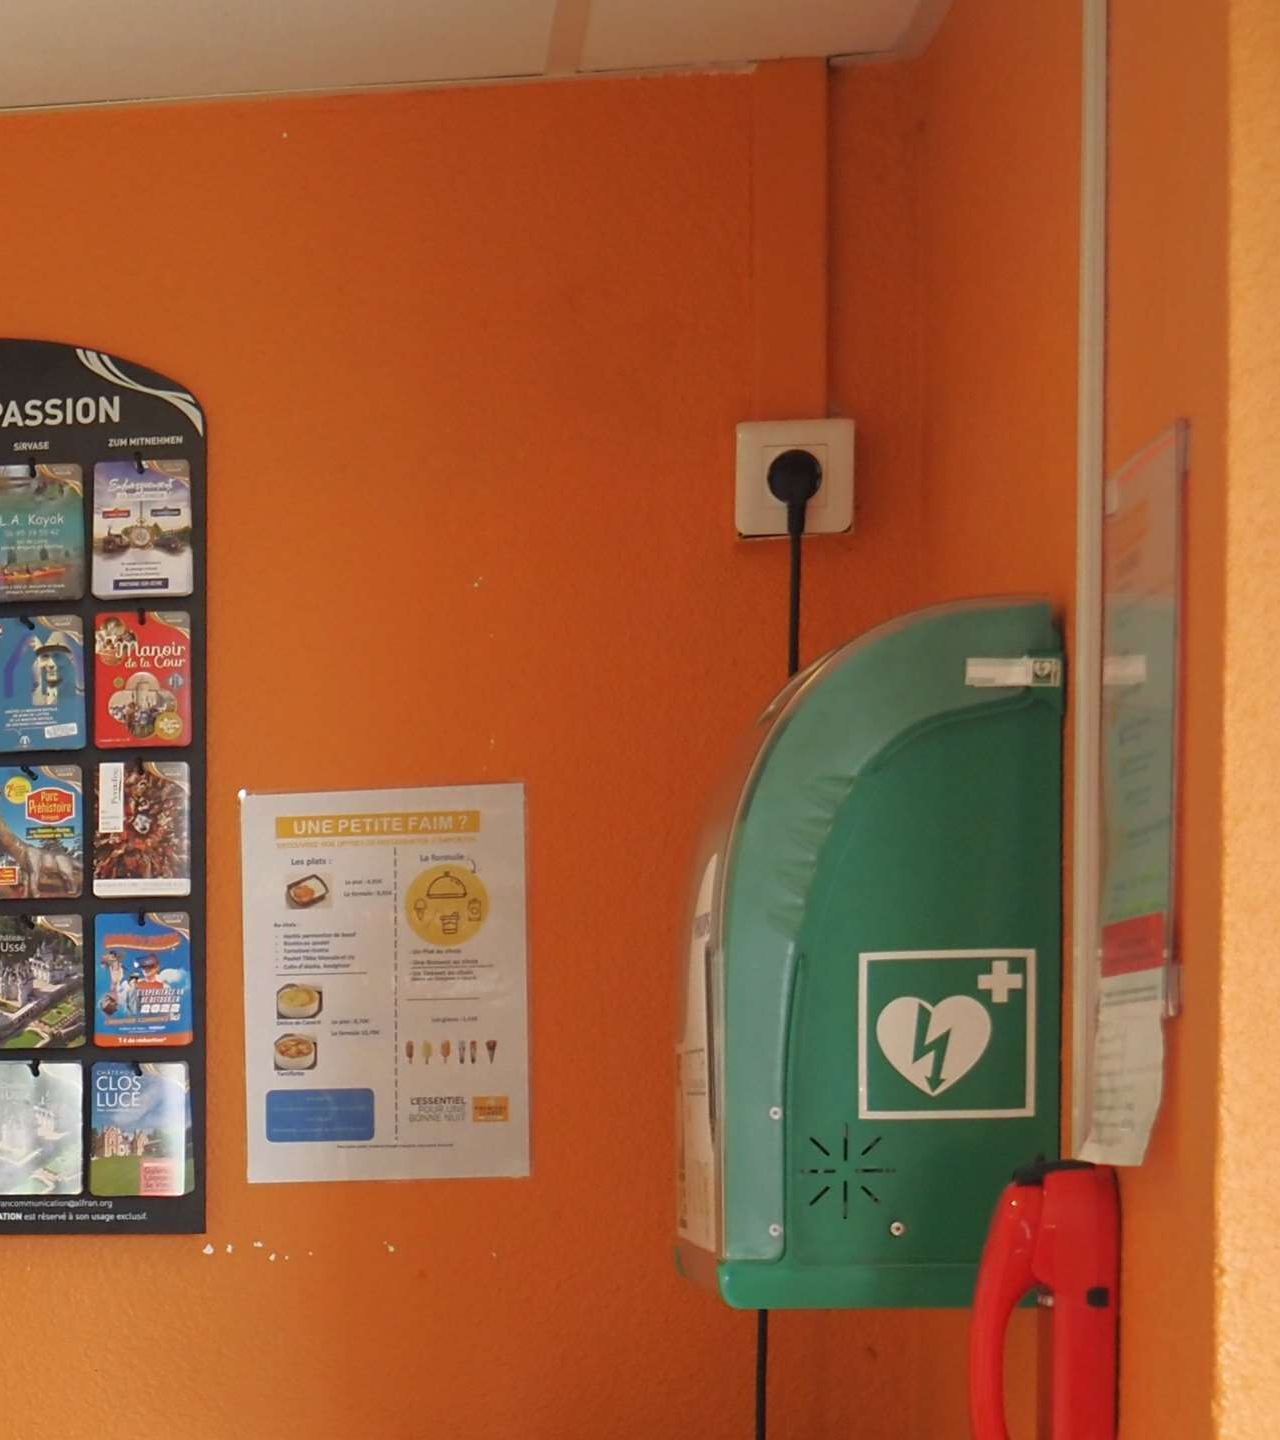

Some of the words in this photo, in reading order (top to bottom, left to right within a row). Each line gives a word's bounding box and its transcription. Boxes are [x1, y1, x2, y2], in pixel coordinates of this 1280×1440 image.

[108, 439, 127, 447] ZUM
[129, 436, 183, 446] MITNEHMEN
[28, 514, 64, 528] Kayak
[115, 641, 185, 657] Manoir
[125, 659, 137, 668] de
[139, 658, 150, 668] la
[154, 656, 186, 668] Cour
[41, 792, 58, 801] Parc
[29, 801, 72, 813] Préhistoire
[293, 820, 333, 834] UNE
[338, 818, 402, 833] PETITE
[409, 816, 453, 831] FAIM
[306, 858, 326, 867] plats
[96, 1076, 141, 1091] CLOS
